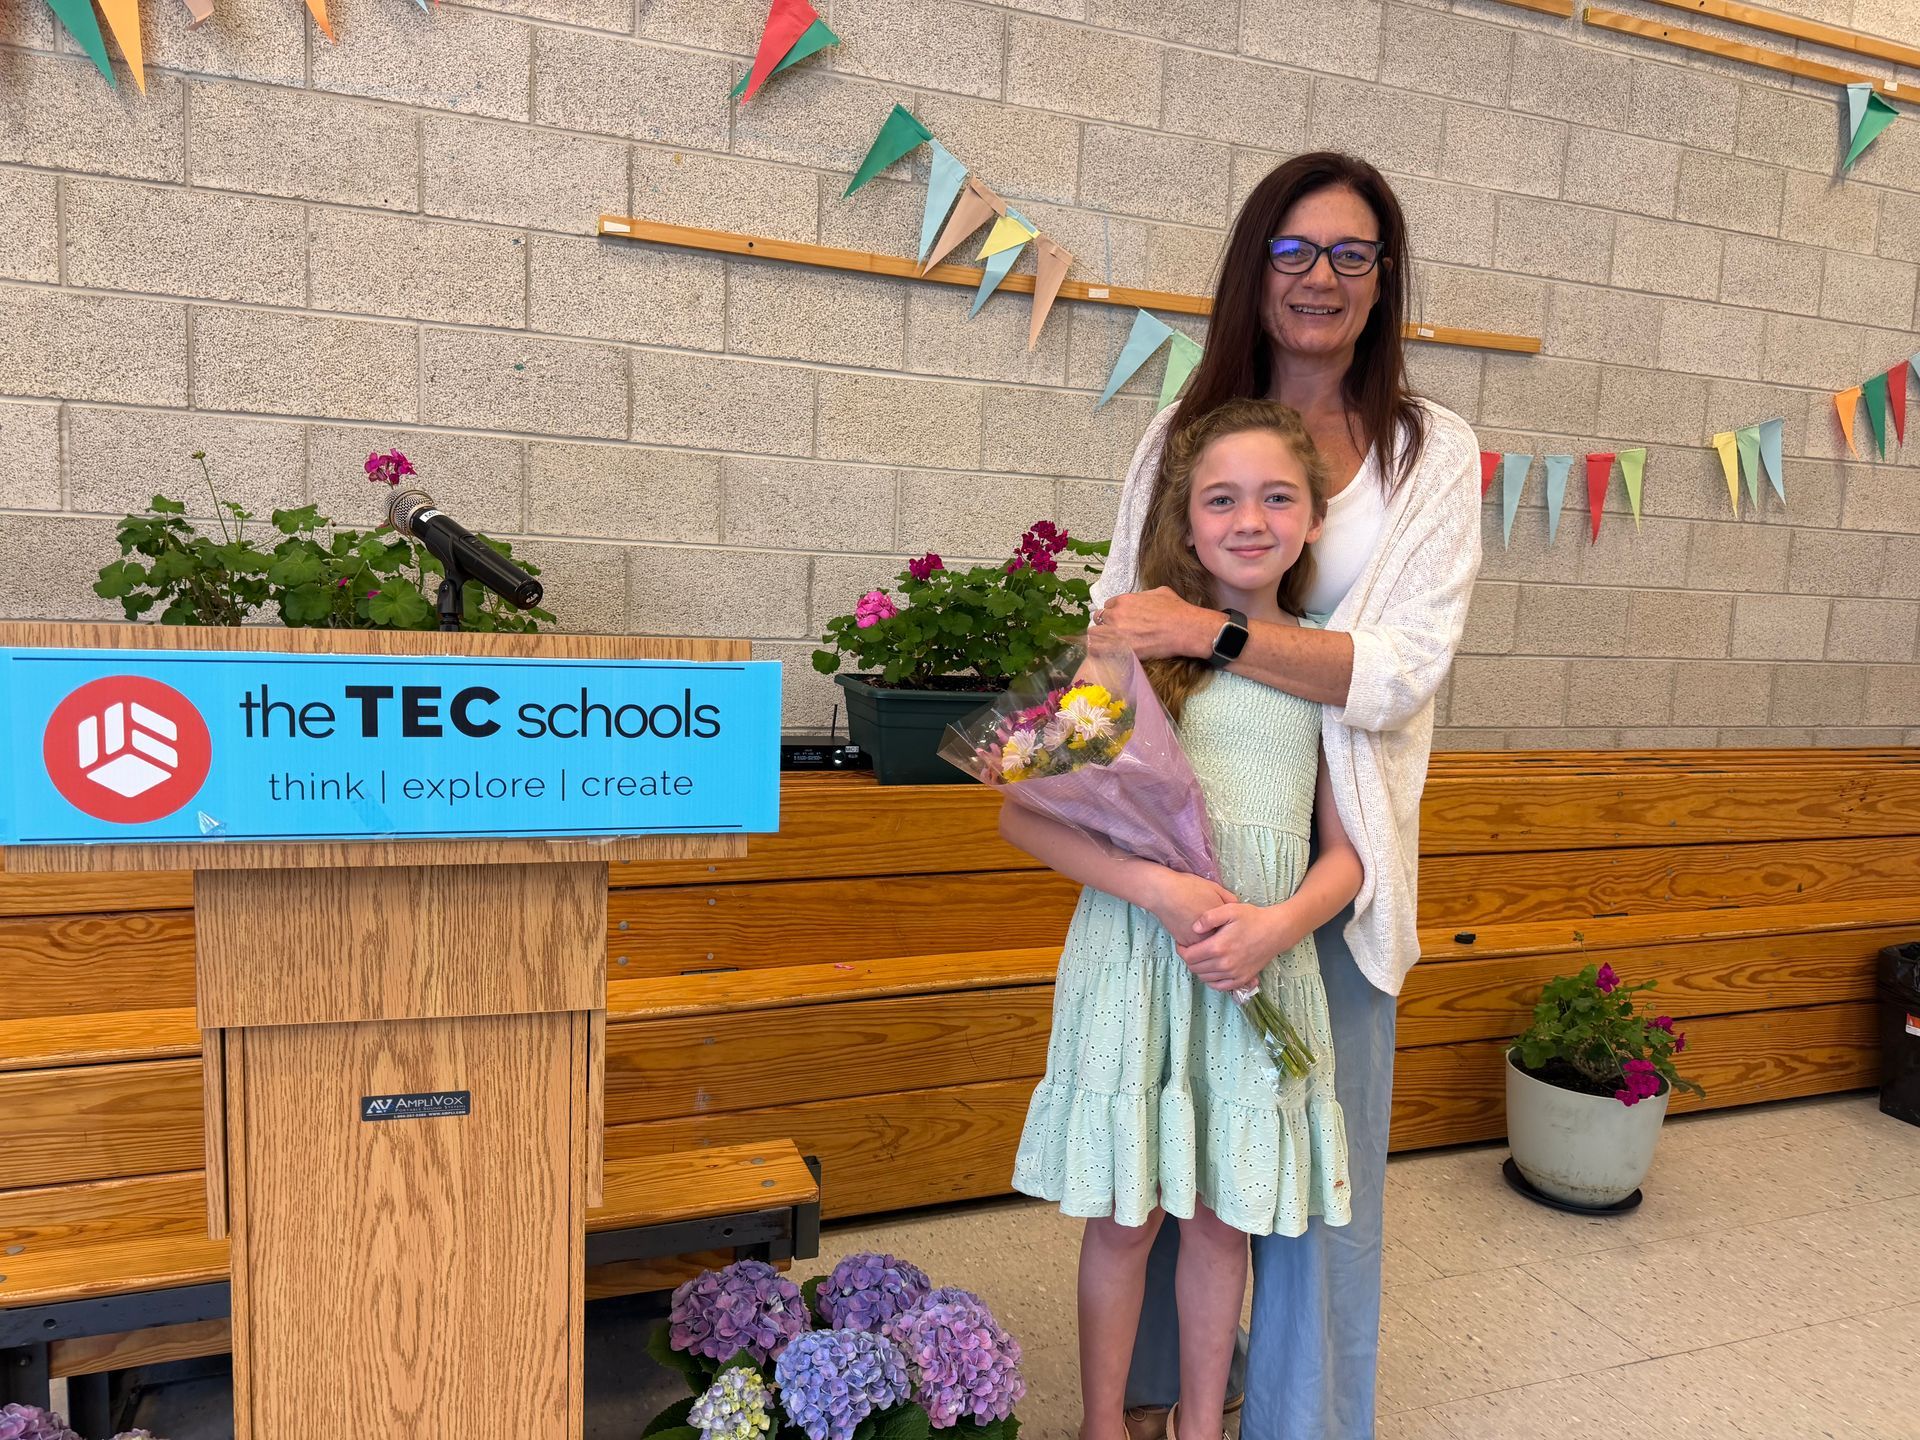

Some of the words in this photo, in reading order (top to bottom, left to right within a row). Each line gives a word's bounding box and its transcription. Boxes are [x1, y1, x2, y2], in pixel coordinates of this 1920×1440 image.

[239, 684, 336, 739] the
[345, 685, 502, 738] TEC
[516, 687, 721, 739] schools
[268, 772, 365, 801] think
[402, 771, 546, 807] explore
[581, 770, 694, 797] create
